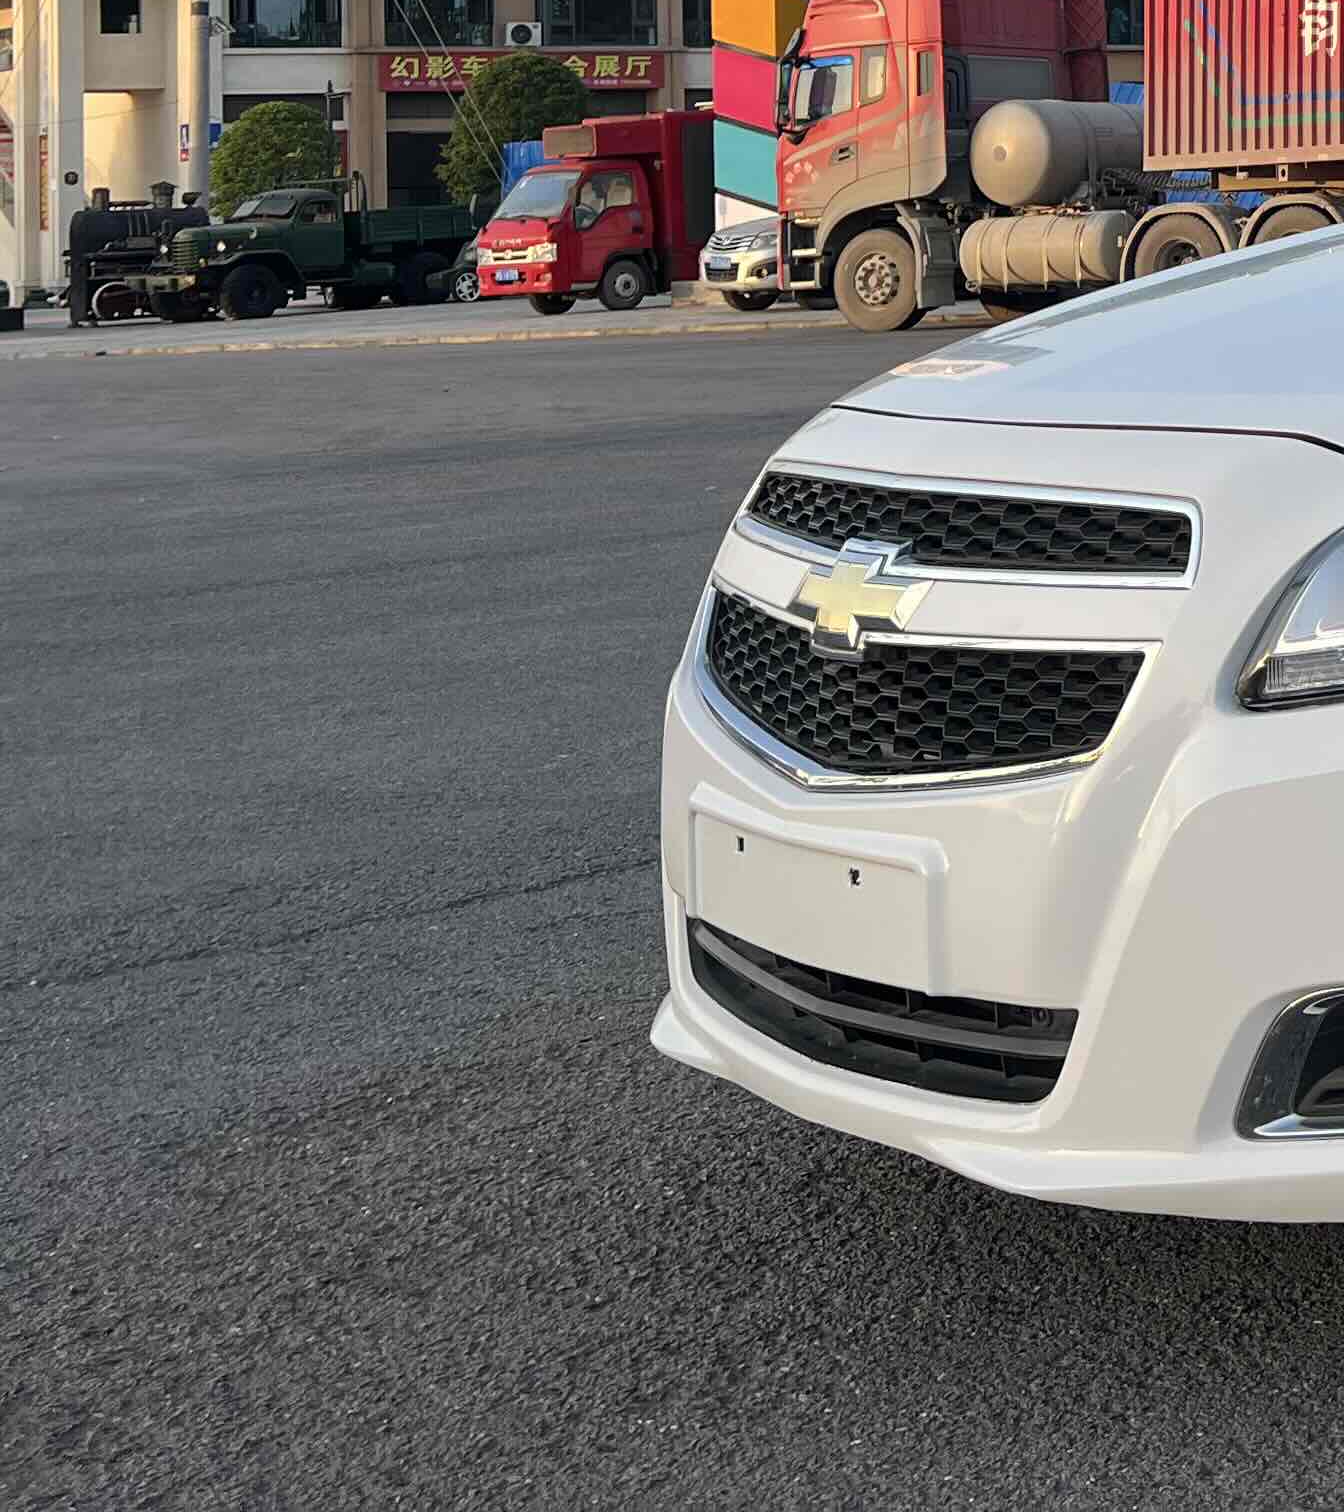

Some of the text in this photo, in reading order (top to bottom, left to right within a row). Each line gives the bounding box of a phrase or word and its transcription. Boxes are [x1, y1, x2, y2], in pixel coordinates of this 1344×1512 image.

[390, 55, 652, 79] 幻影车合展厅
